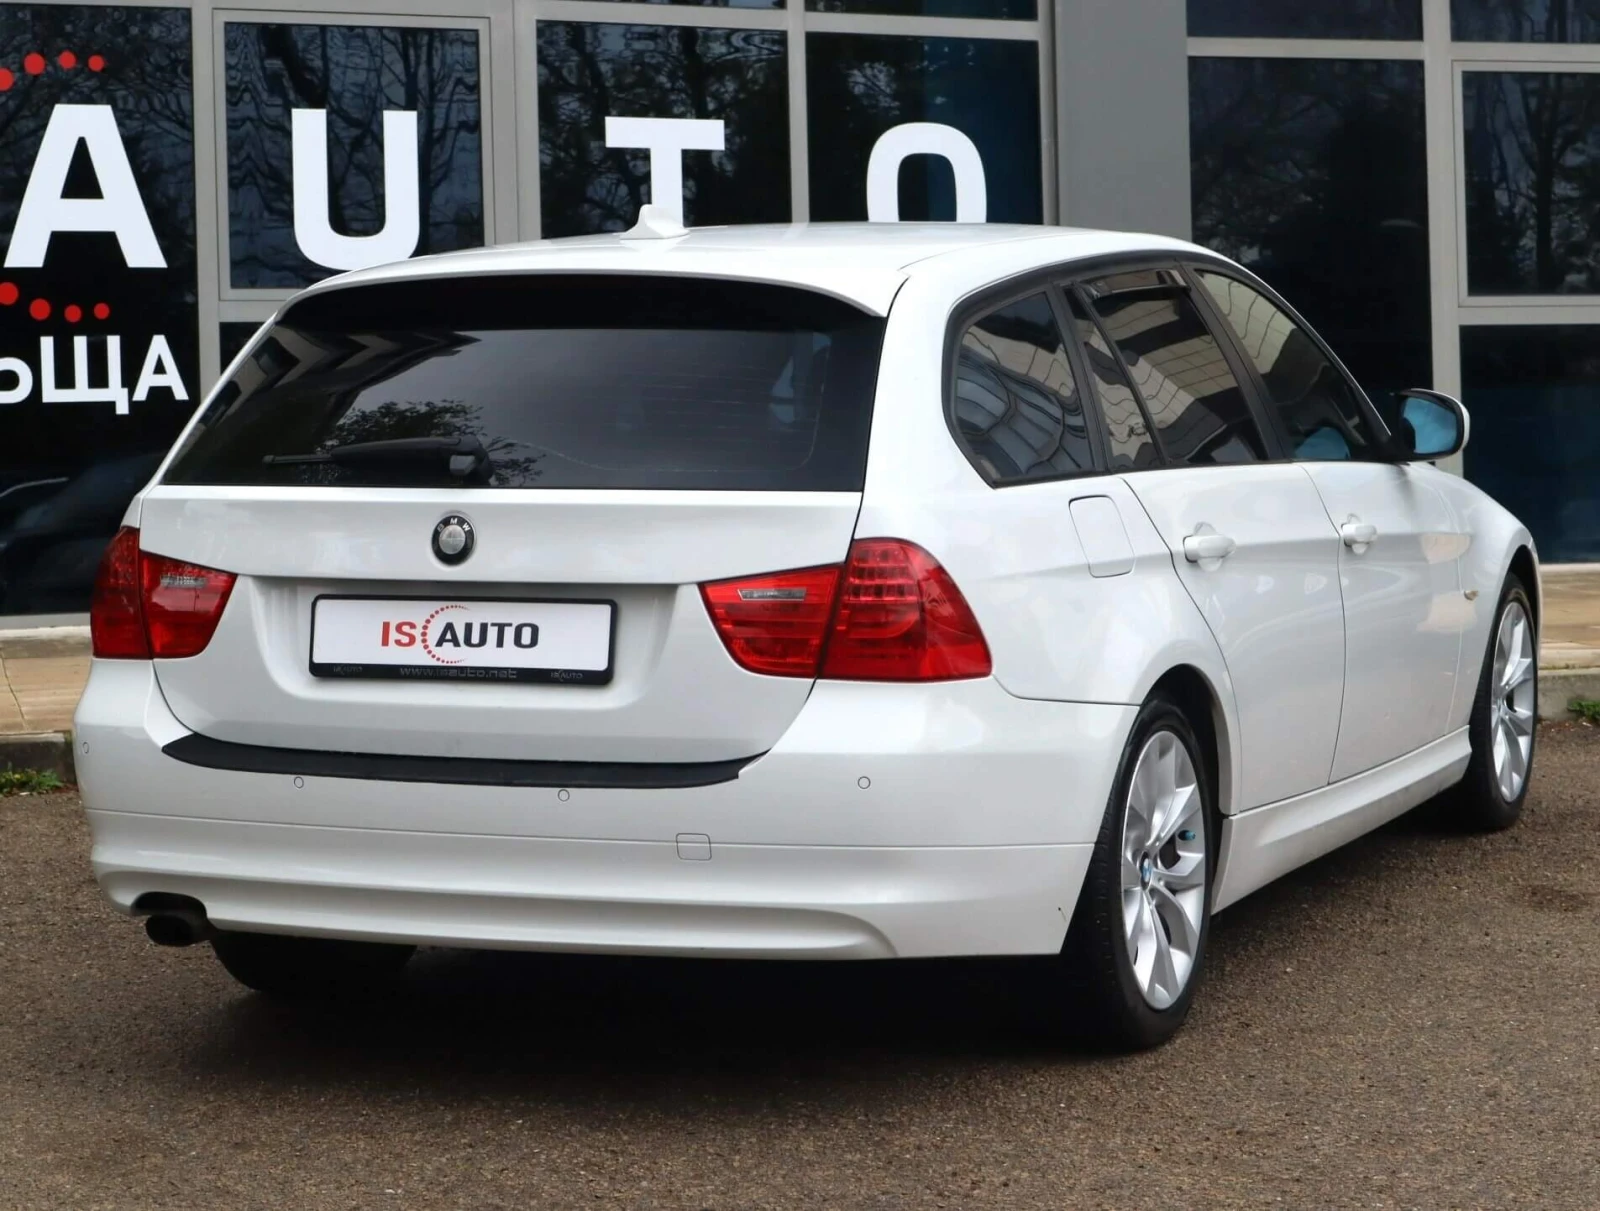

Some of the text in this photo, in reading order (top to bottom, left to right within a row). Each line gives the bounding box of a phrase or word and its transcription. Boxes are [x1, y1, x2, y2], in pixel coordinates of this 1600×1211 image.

[4, 104, 988, 270] AUTO
[437, 517, 471, 532] BMW
[435, 621, 540, 649] AUTO
[400, 667, 518, 679] www.isauto.net
